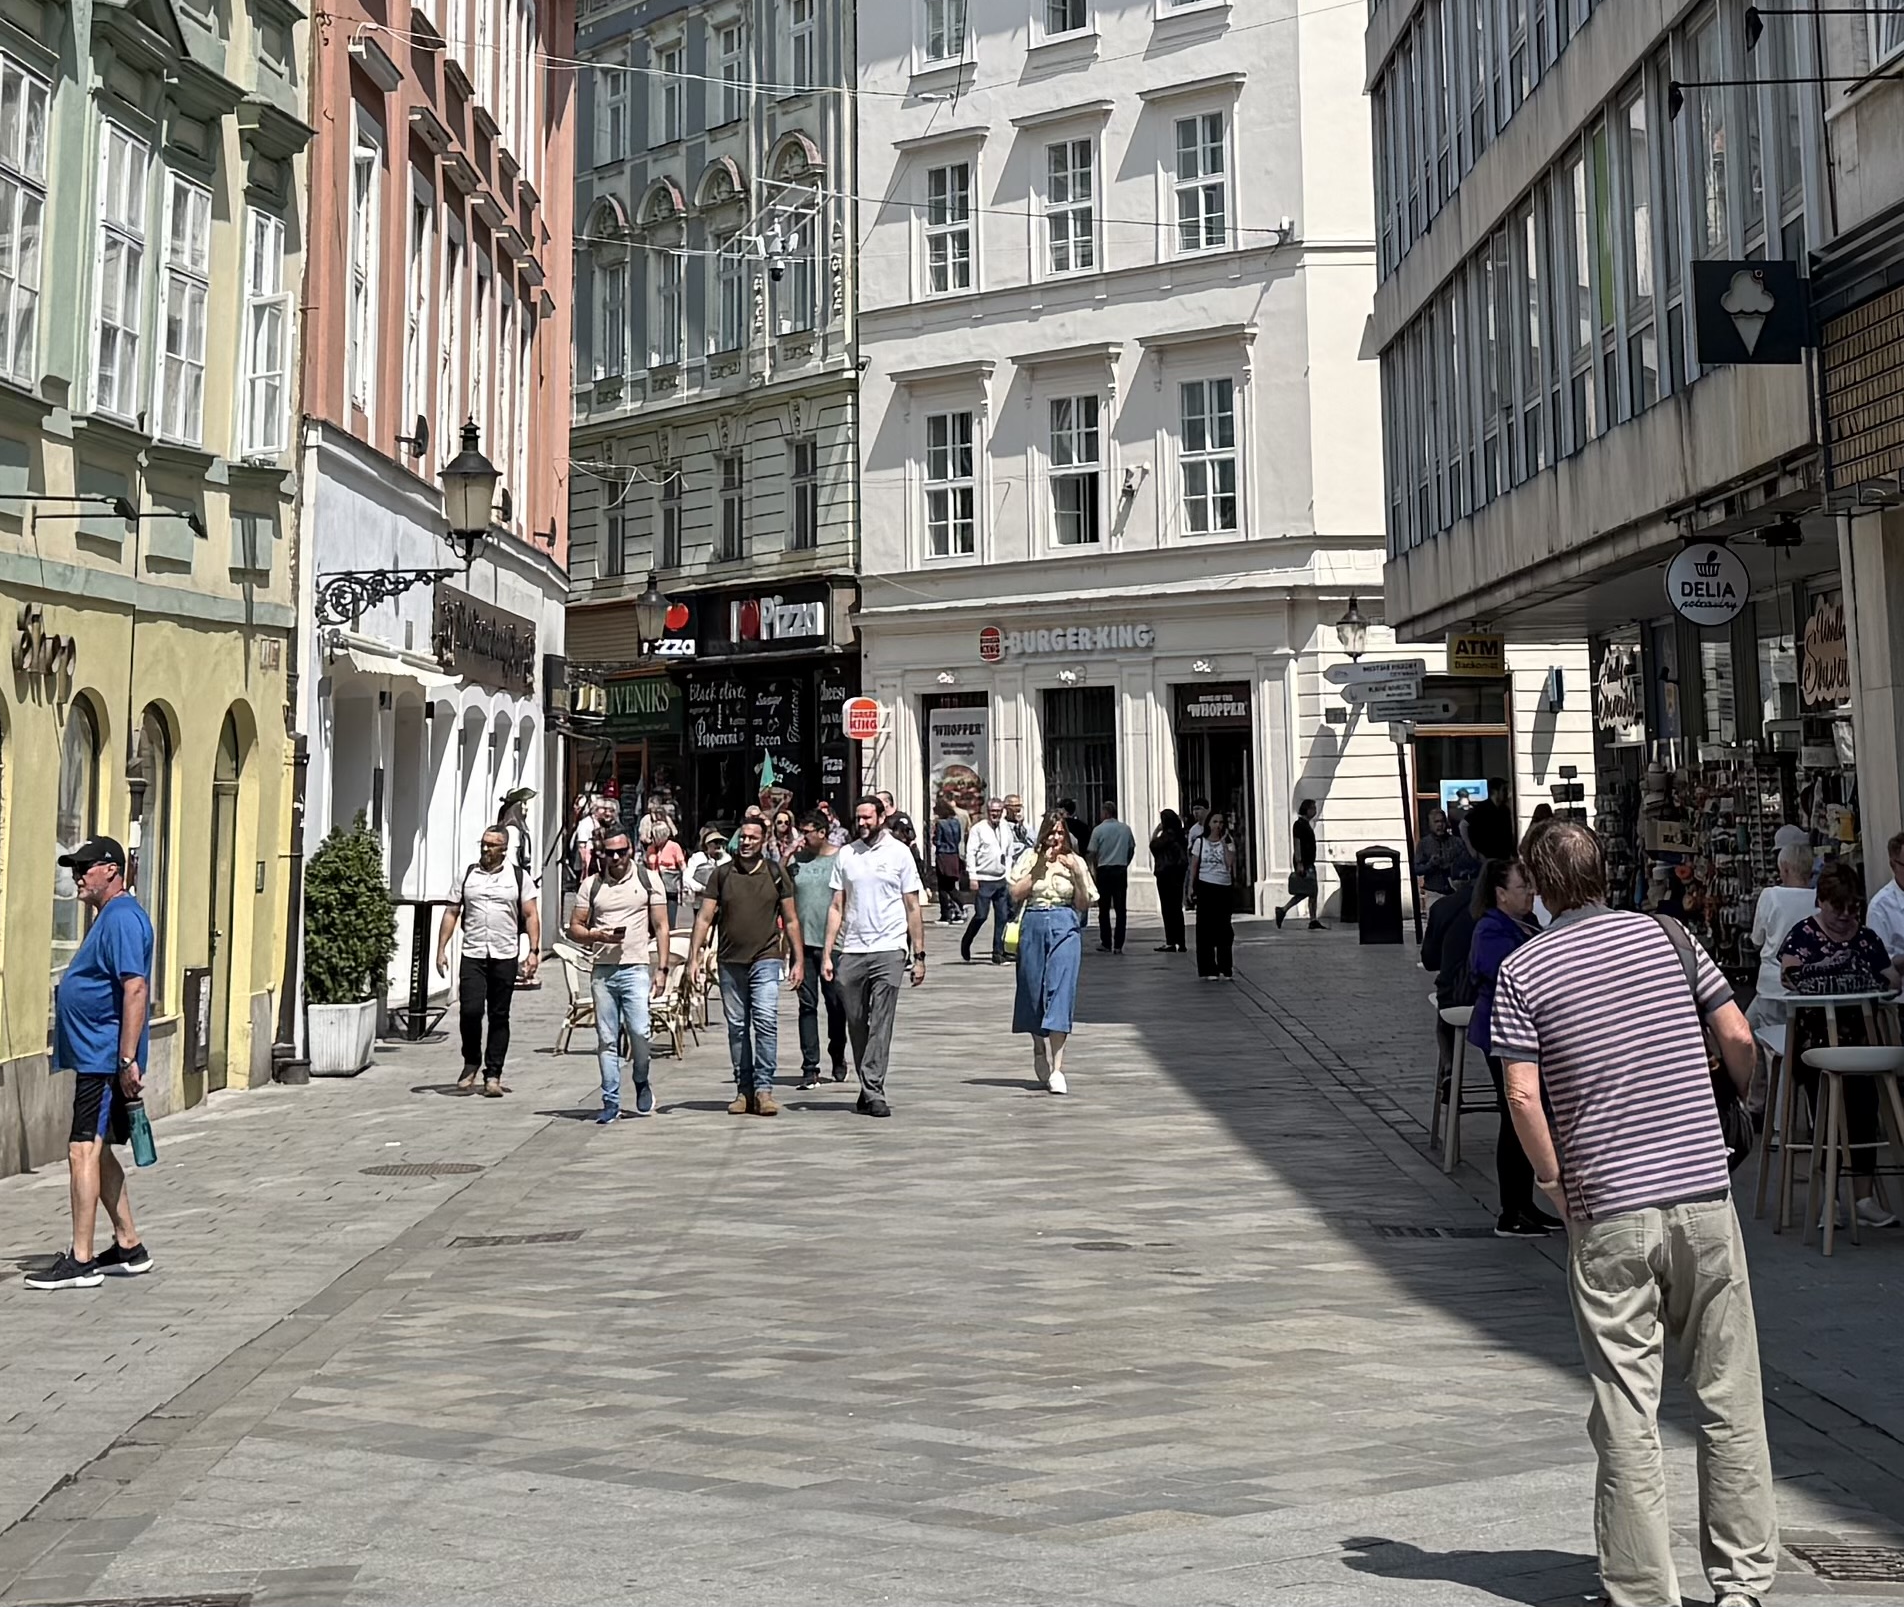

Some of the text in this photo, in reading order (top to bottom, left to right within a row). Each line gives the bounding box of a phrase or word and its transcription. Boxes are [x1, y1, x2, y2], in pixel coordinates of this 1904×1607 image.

[1680, 581, 1736, 599] DELIA
[759, 594, 825, 641] Pizza
[1006, 624, 1152, 654] BURGER KING
[1455, 639, 1499, 656] ATM
[1186, 702, 1246, 718] WHOPPER
